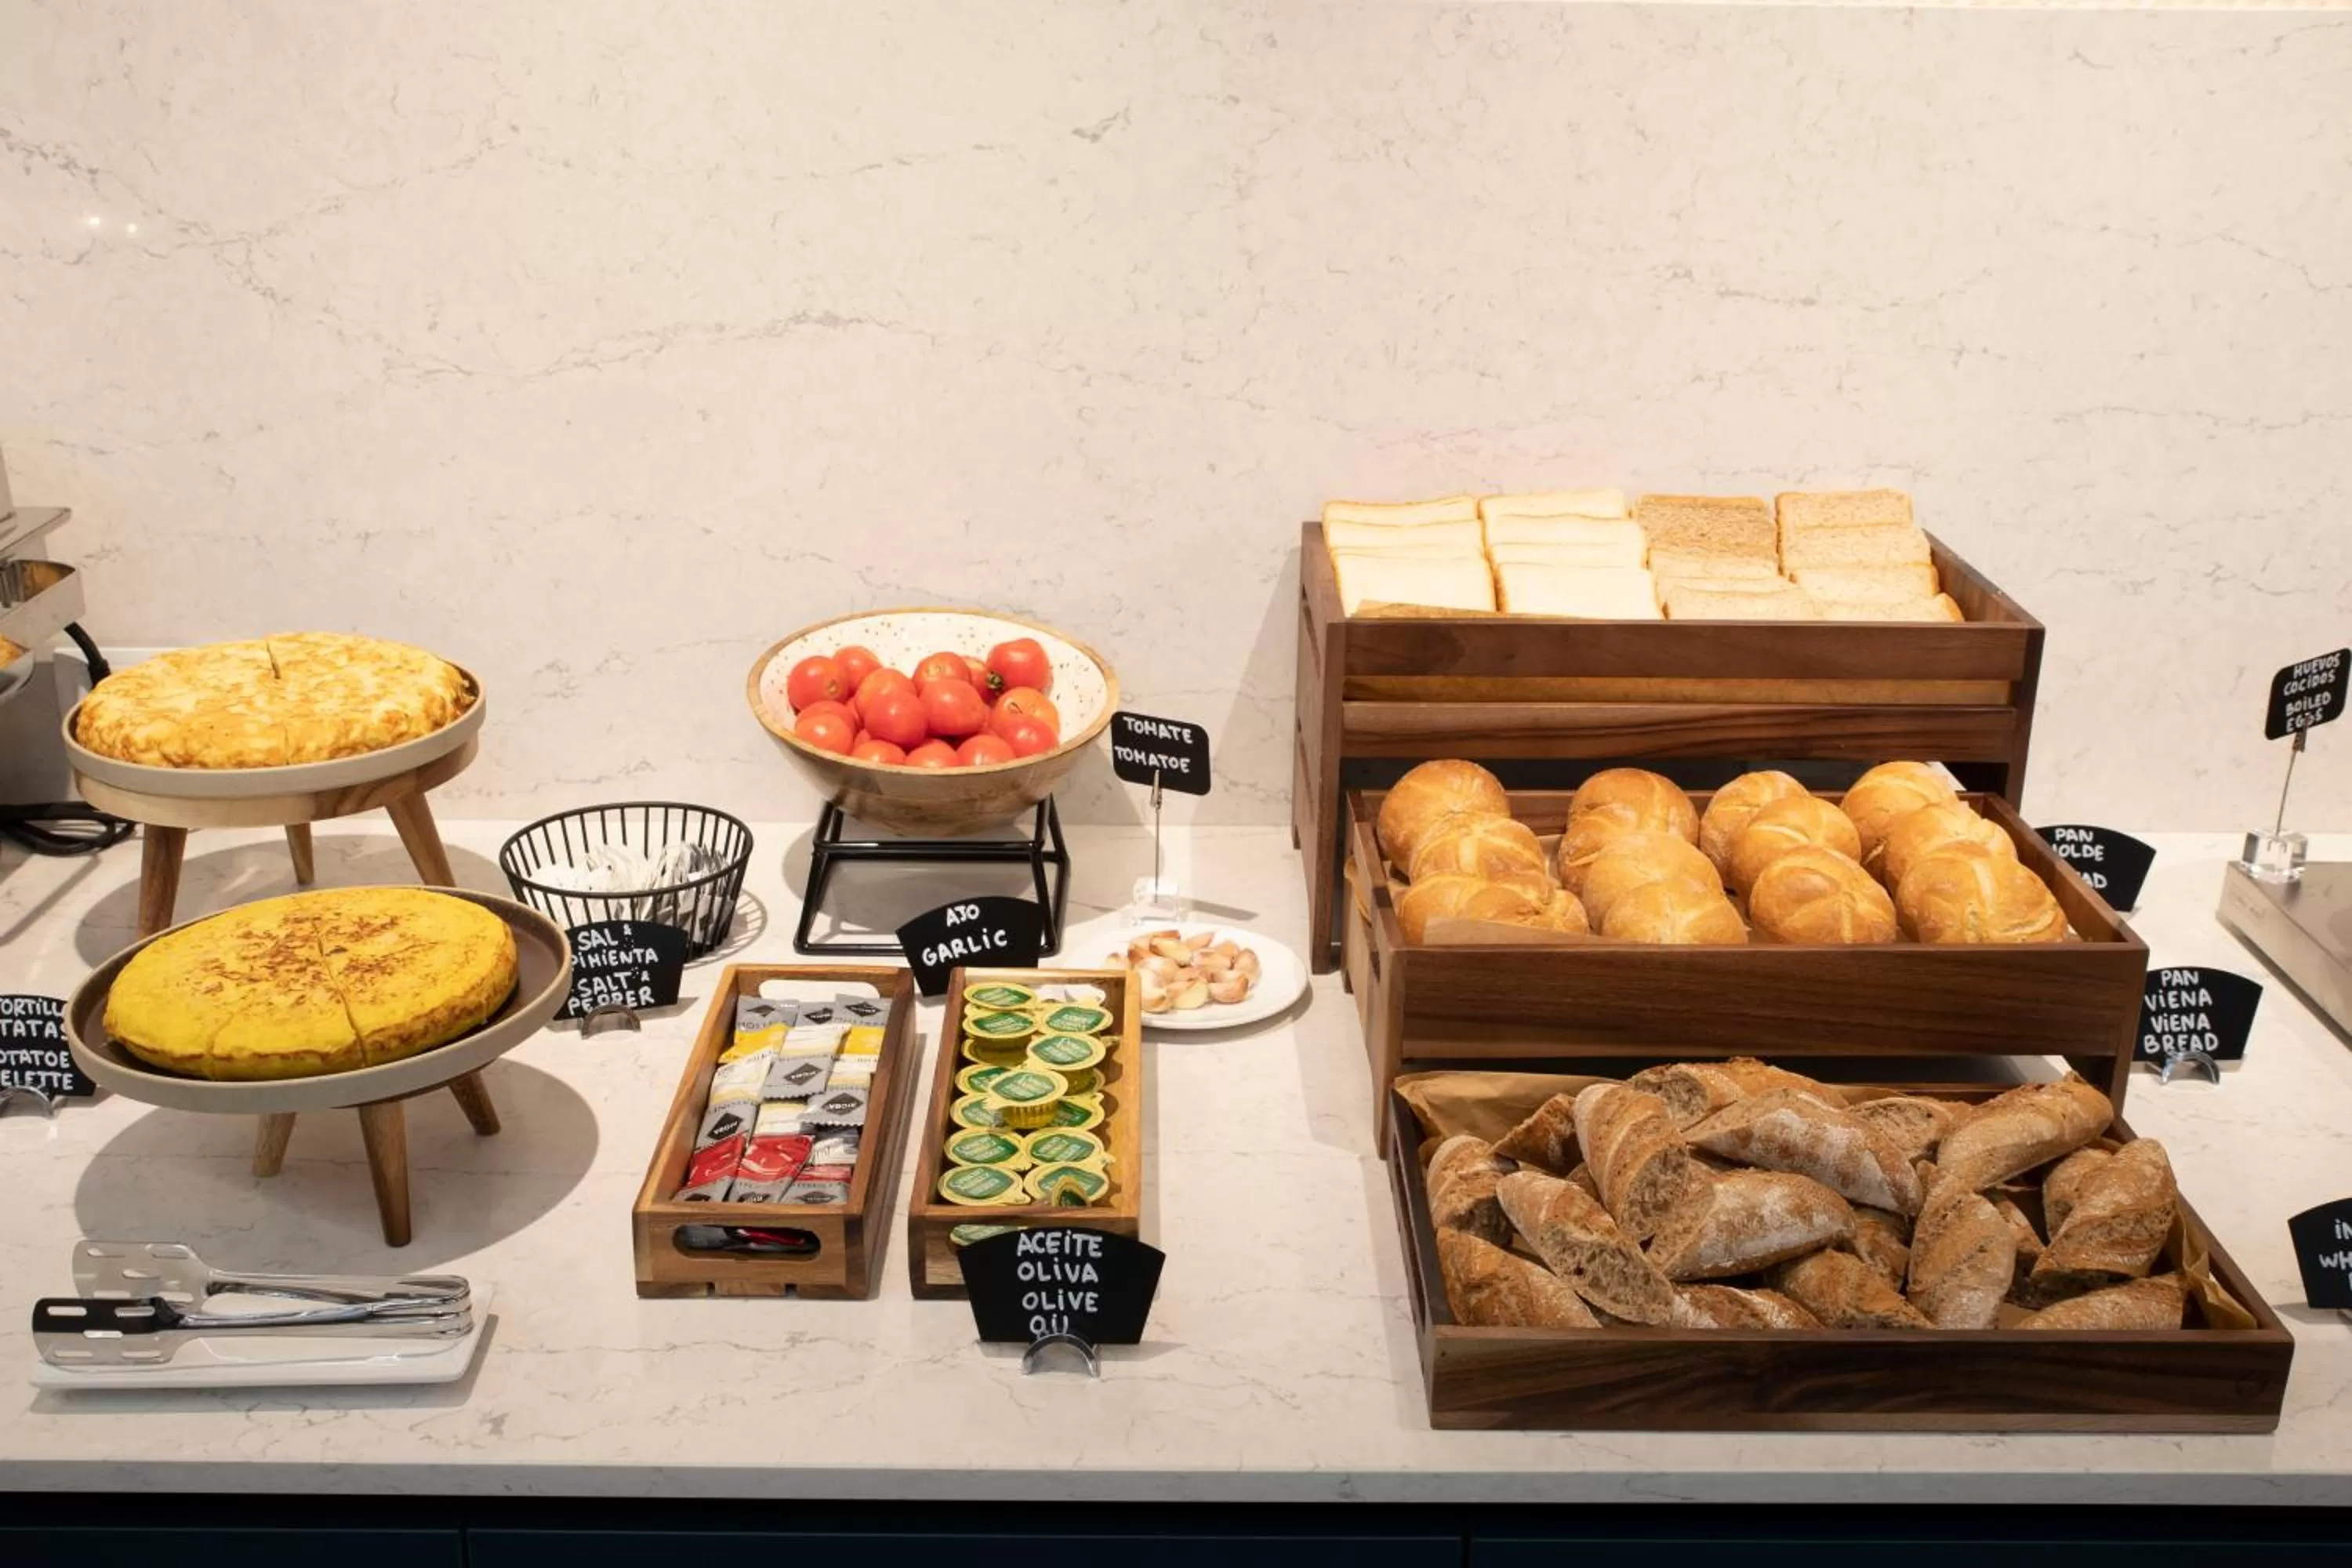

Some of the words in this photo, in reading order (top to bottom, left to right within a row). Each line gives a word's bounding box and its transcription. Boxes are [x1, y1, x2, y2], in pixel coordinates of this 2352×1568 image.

[2293, 652, 2340, 679] HUEVOS
[1123, 716, 1193, 744] TOMATE
[1114, 746, 1191, 773] TOMATOE
[2055, 828, 2094, 842] PAN
[946, 904, 980, 927] AJO
[577, 928, 619, 951] SAL
[577, 971, 632, 998] SALT
[2161, 970, 2199, 987] PAN
[568, 985, 655, 1016] PEPPER
[2143, 1033, 2219, 1054] BREAD
